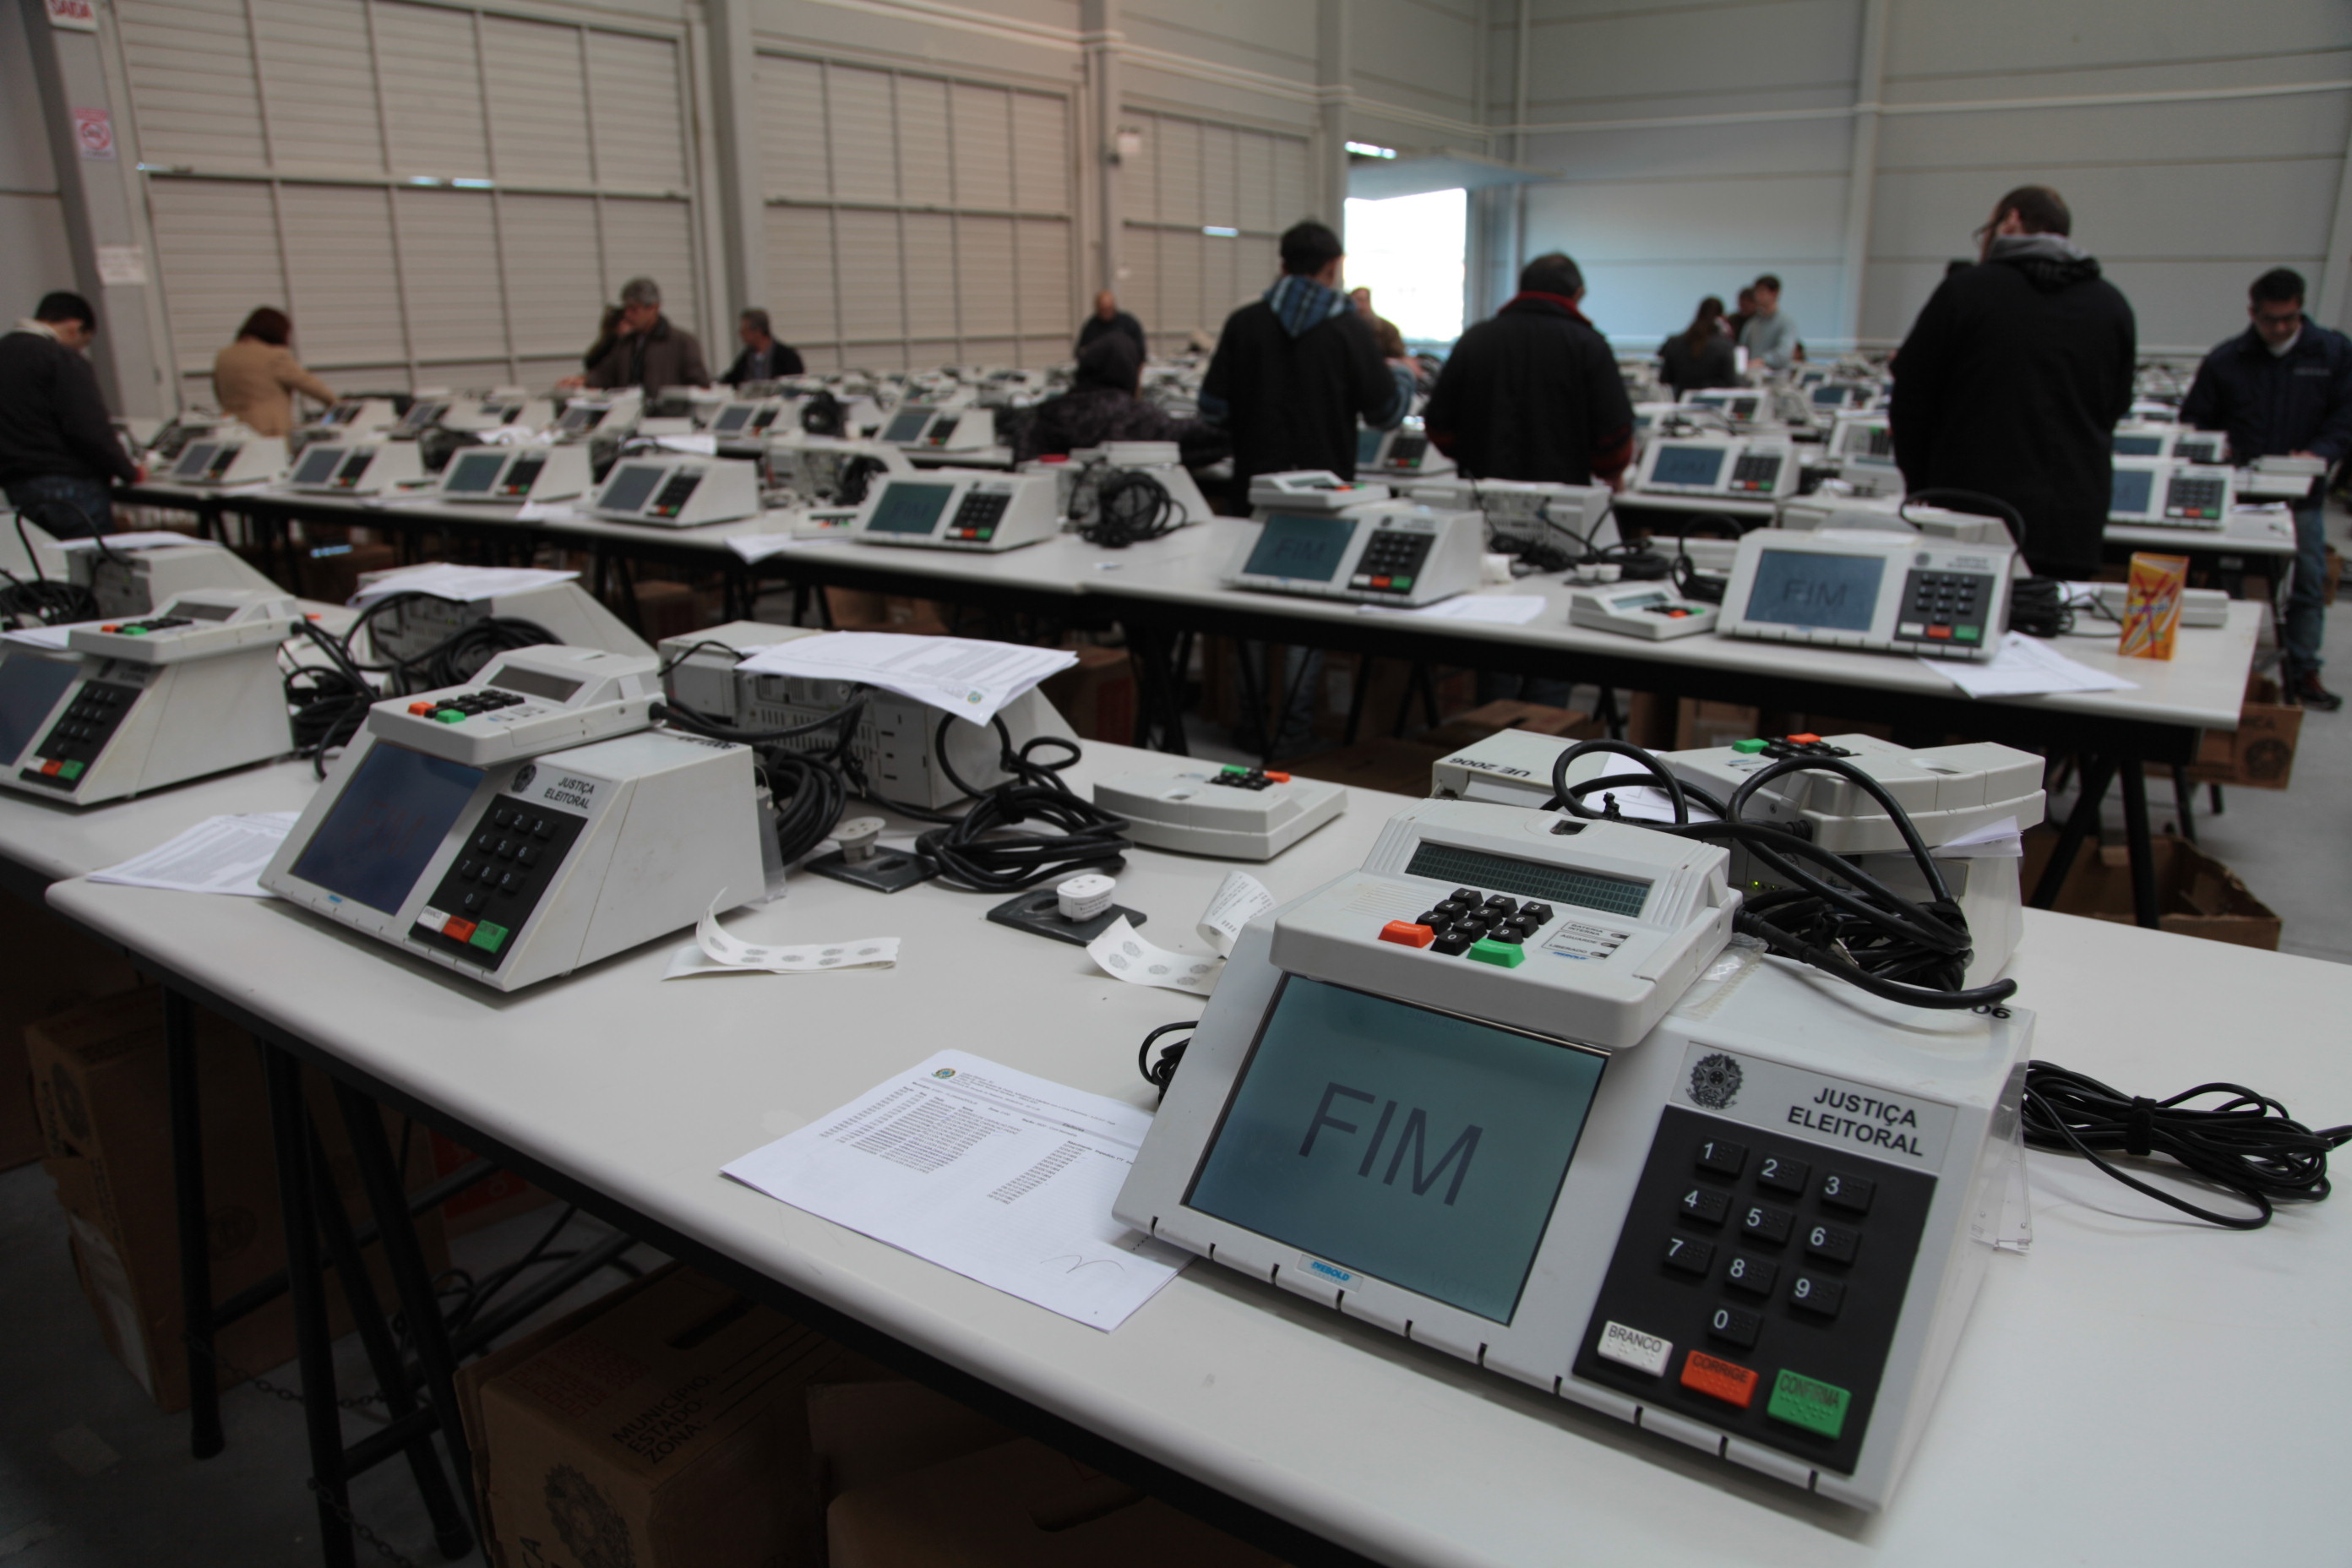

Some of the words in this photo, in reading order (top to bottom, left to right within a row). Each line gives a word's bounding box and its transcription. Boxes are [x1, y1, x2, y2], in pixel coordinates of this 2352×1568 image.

[1781, 578, 1848, 607] FIM
[1449, 758, 1498, 770] 2006
[1499, 766, 1531, 777] UE
[544, 787, 589, 809] ELEITORAL
[558, 777, 595, 795] JUSTIÇA
[496, 809, 502, 819] 1
[514, 814, 523, 825] 2
[534, 820, 542, 830] 3
[478, 835, 487, 844] 4
[498, 840, 507, 851] 5
[519, 847, 527, 857] 6
[462, 860, 471, 870] 7
[482, 867, 490, 877] 8
[502, 874, 510, 884] 9
[466, 893, 473, 904] 0
[1560, 934, 1598, 944] AGUARDE
[1568, 927, 1600, 936] INTERNA
[1549, 944, 1588, 954] LIBERADO
[1814, 1087, 1917, 1129] JUSTIÇA
[1298, 1081, 1484, 1206] FIM
[1788, 1106, 1924, 1157] ELEITORAL
[1704, 1142, 1713, 1159] 1
[1761, 1158, 1778, 1177] 2
[1825, 1176, 1840, 1195] 3
[1685, 1190, 1698, 1207] 4
[1746, 1208, 1762, 1226] 5
[1810, 1228, 1826, 1245] 6
[1311, 1261, 1350, 1281] DIEBOLD
[1669, 1239, 1684, 1256] 7
[1730, 1259, 1745, 1277] 8
[1794, 1278, 1810, 1298] 9
[1713, 1310, 1729, 1329] 0
[1609, 1325, 1662, 1353] BRANCO
[1693, 1355, 1749, 1383] CORRIGE
[1779, 1374, 1839, 1408] CONFIRMA
[612, 1375, 717, 1444] MUNICÍPIO:
[627, 1398, 710, 1453] ESTADO:
[643, 1419, 707, 1465] ZONA:
